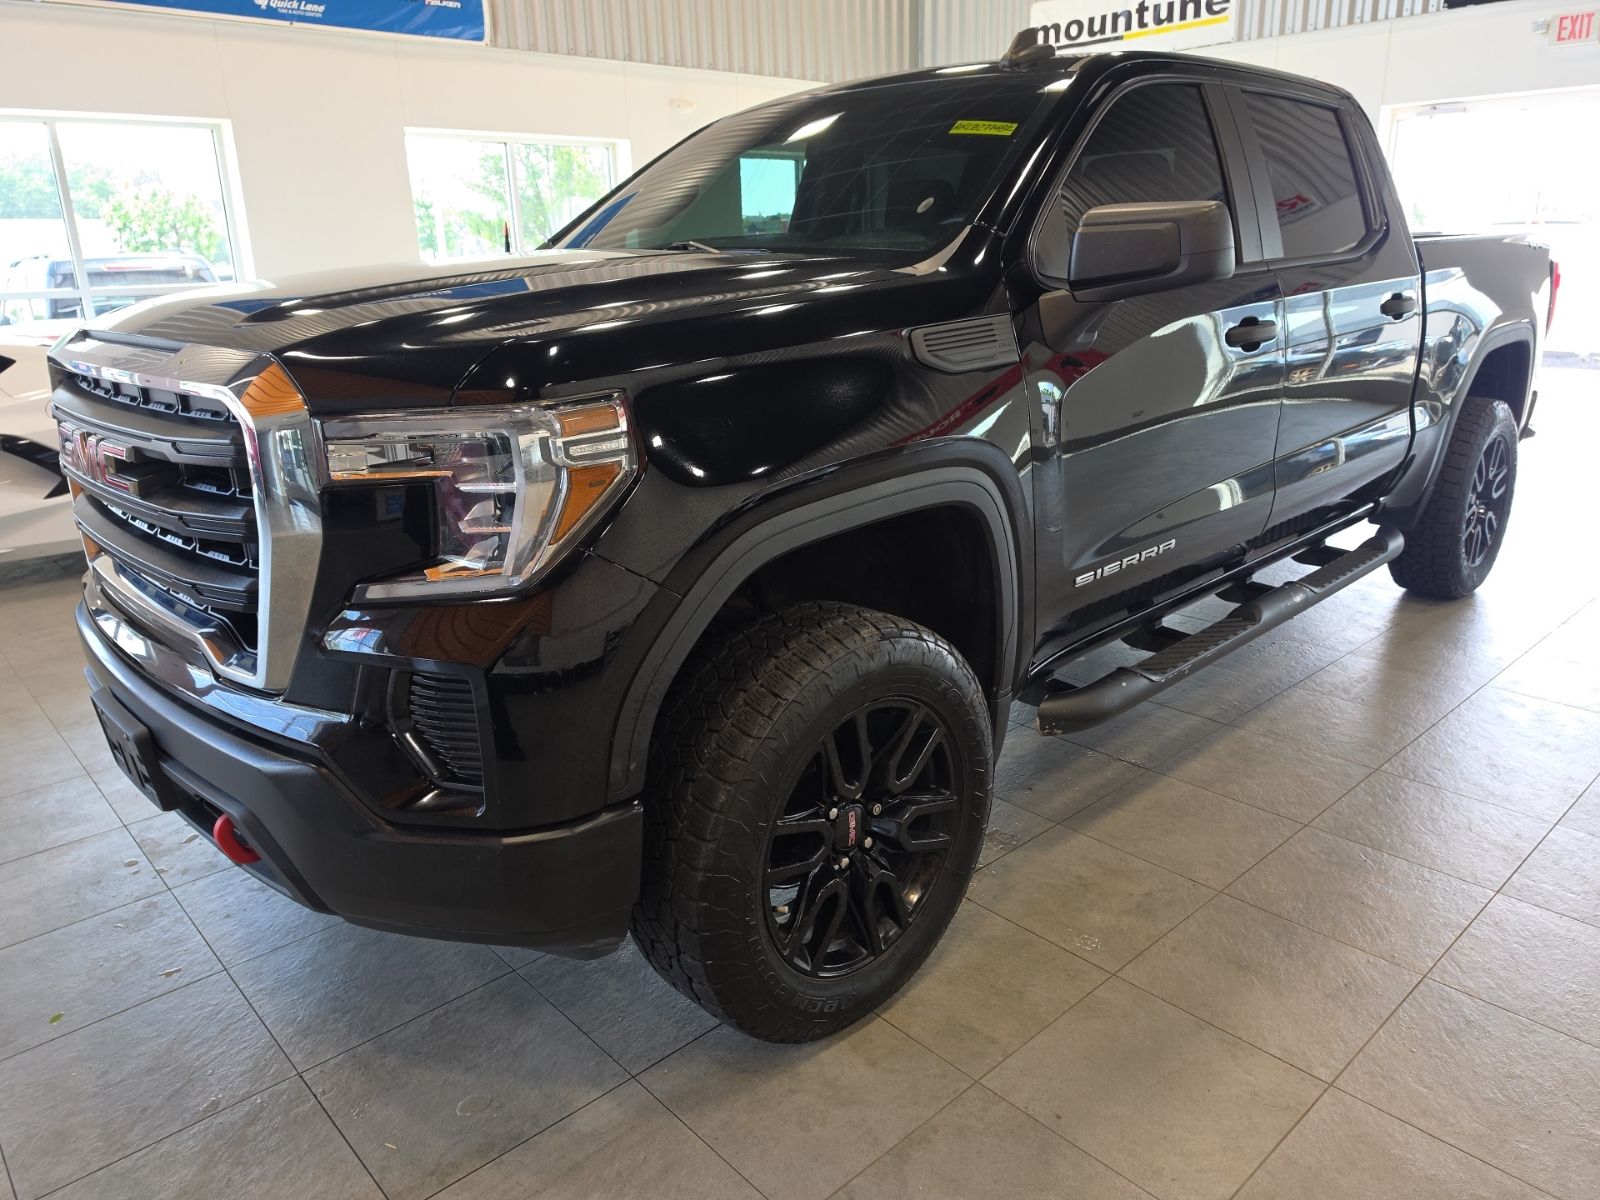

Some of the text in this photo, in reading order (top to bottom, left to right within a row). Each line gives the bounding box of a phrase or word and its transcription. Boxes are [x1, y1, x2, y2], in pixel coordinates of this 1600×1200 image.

[270, 0, 326, 12] Quick Lane
[1035, 0, 1230, 45] mountune
[1556, 12, 1595, 42] EXIT
[59, 422, 139, 496] GMC
[1073, 538, 1176, 588] SIERRA
[848, 810, 857, 847] GMC
